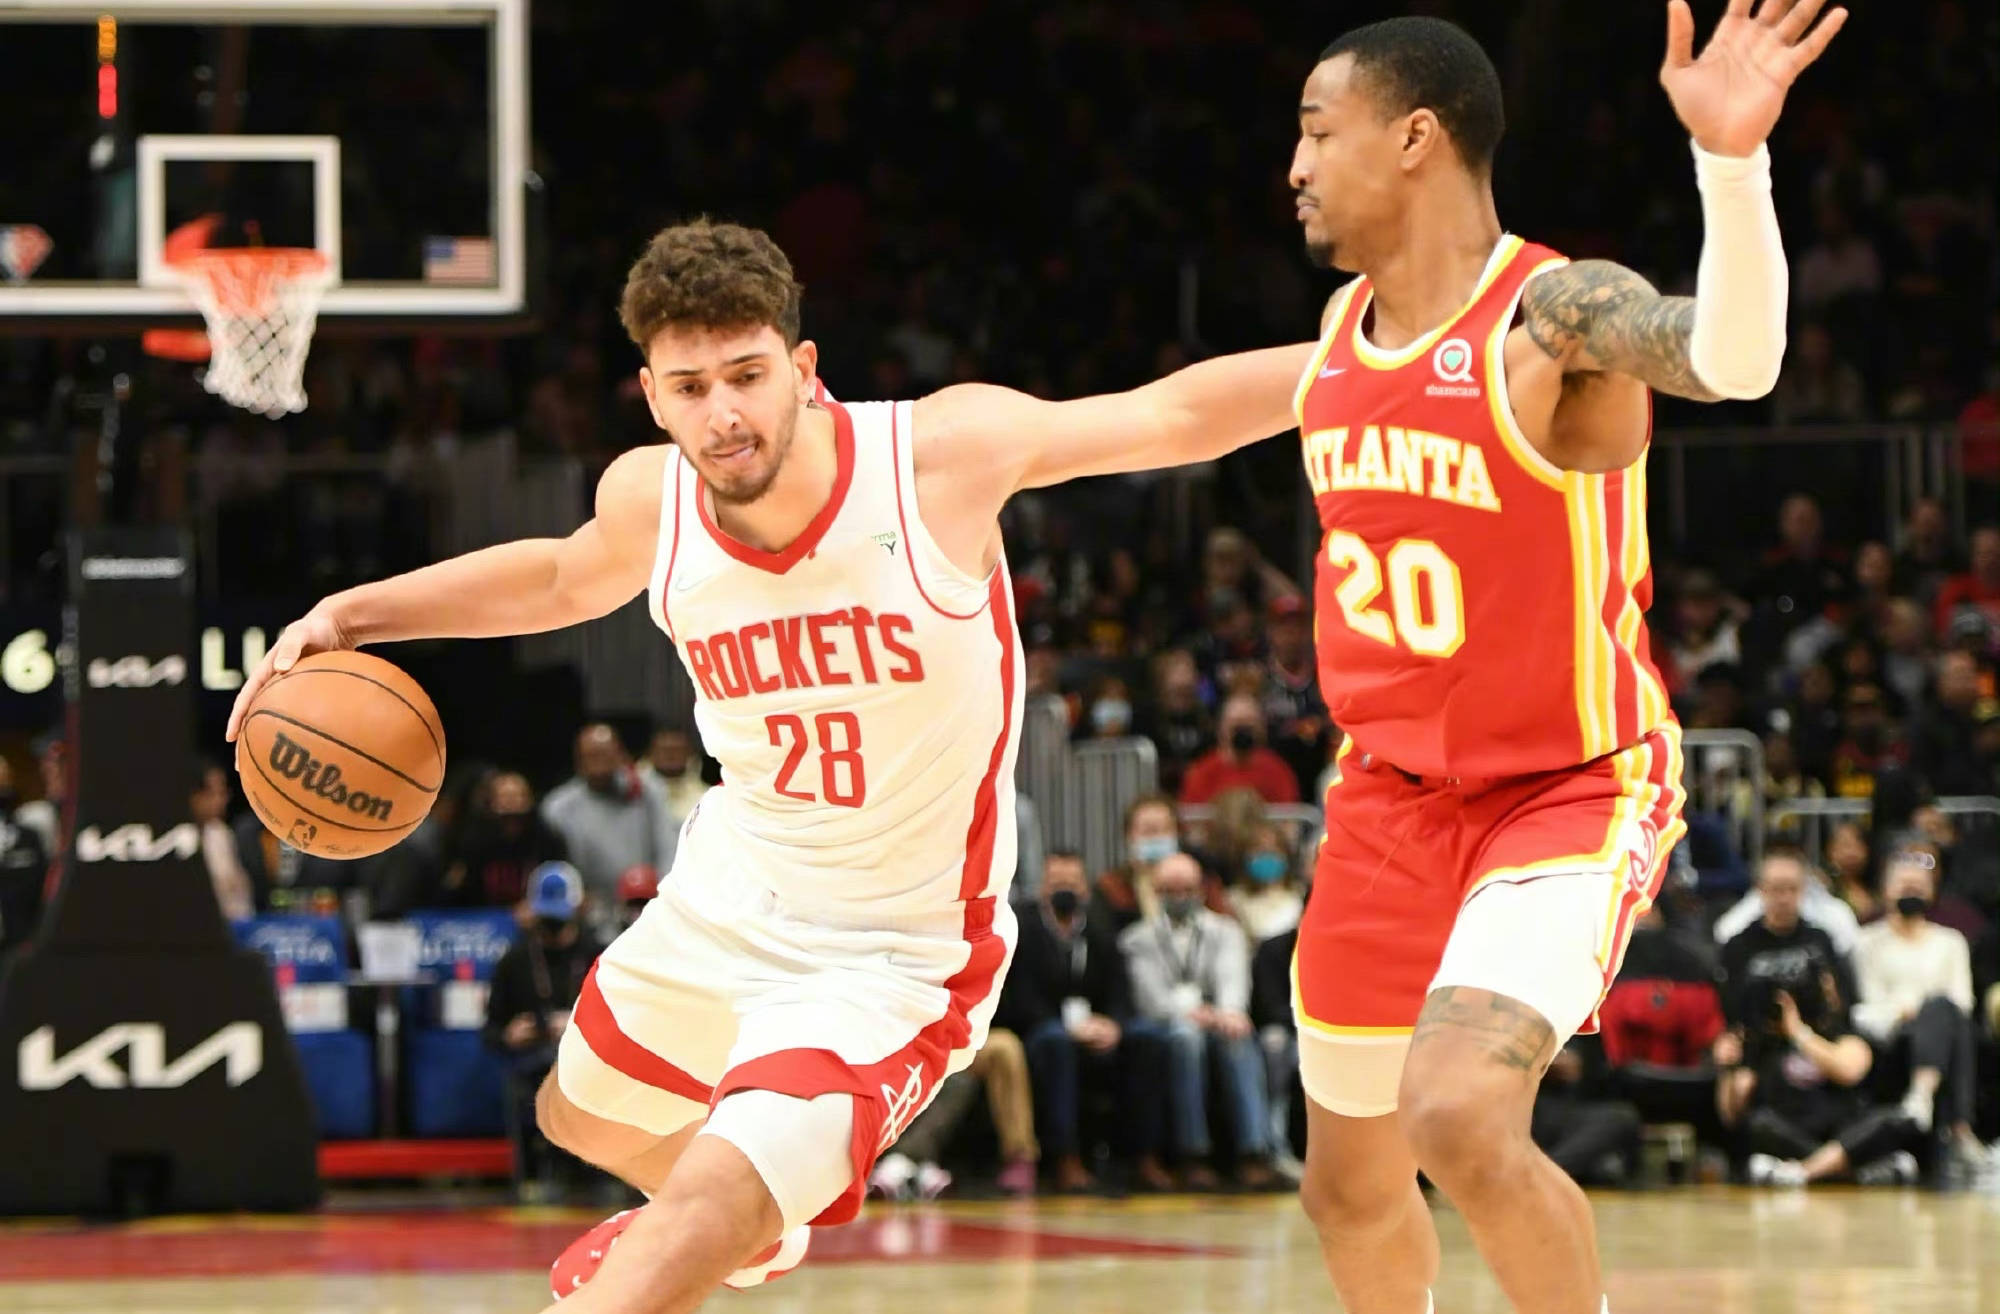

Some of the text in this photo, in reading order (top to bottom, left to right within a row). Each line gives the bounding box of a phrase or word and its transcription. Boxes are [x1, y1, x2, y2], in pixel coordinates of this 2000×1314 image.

[1328, 529, 1466, 659] 20
[2, 629, 55, 693] 6
[686, 606, 924, 700] ROCKETS
[269, 731, 393, 822] Wilson
[764, 712, 866, 808] 28
[18, 1021, 262, 1090] KIA
